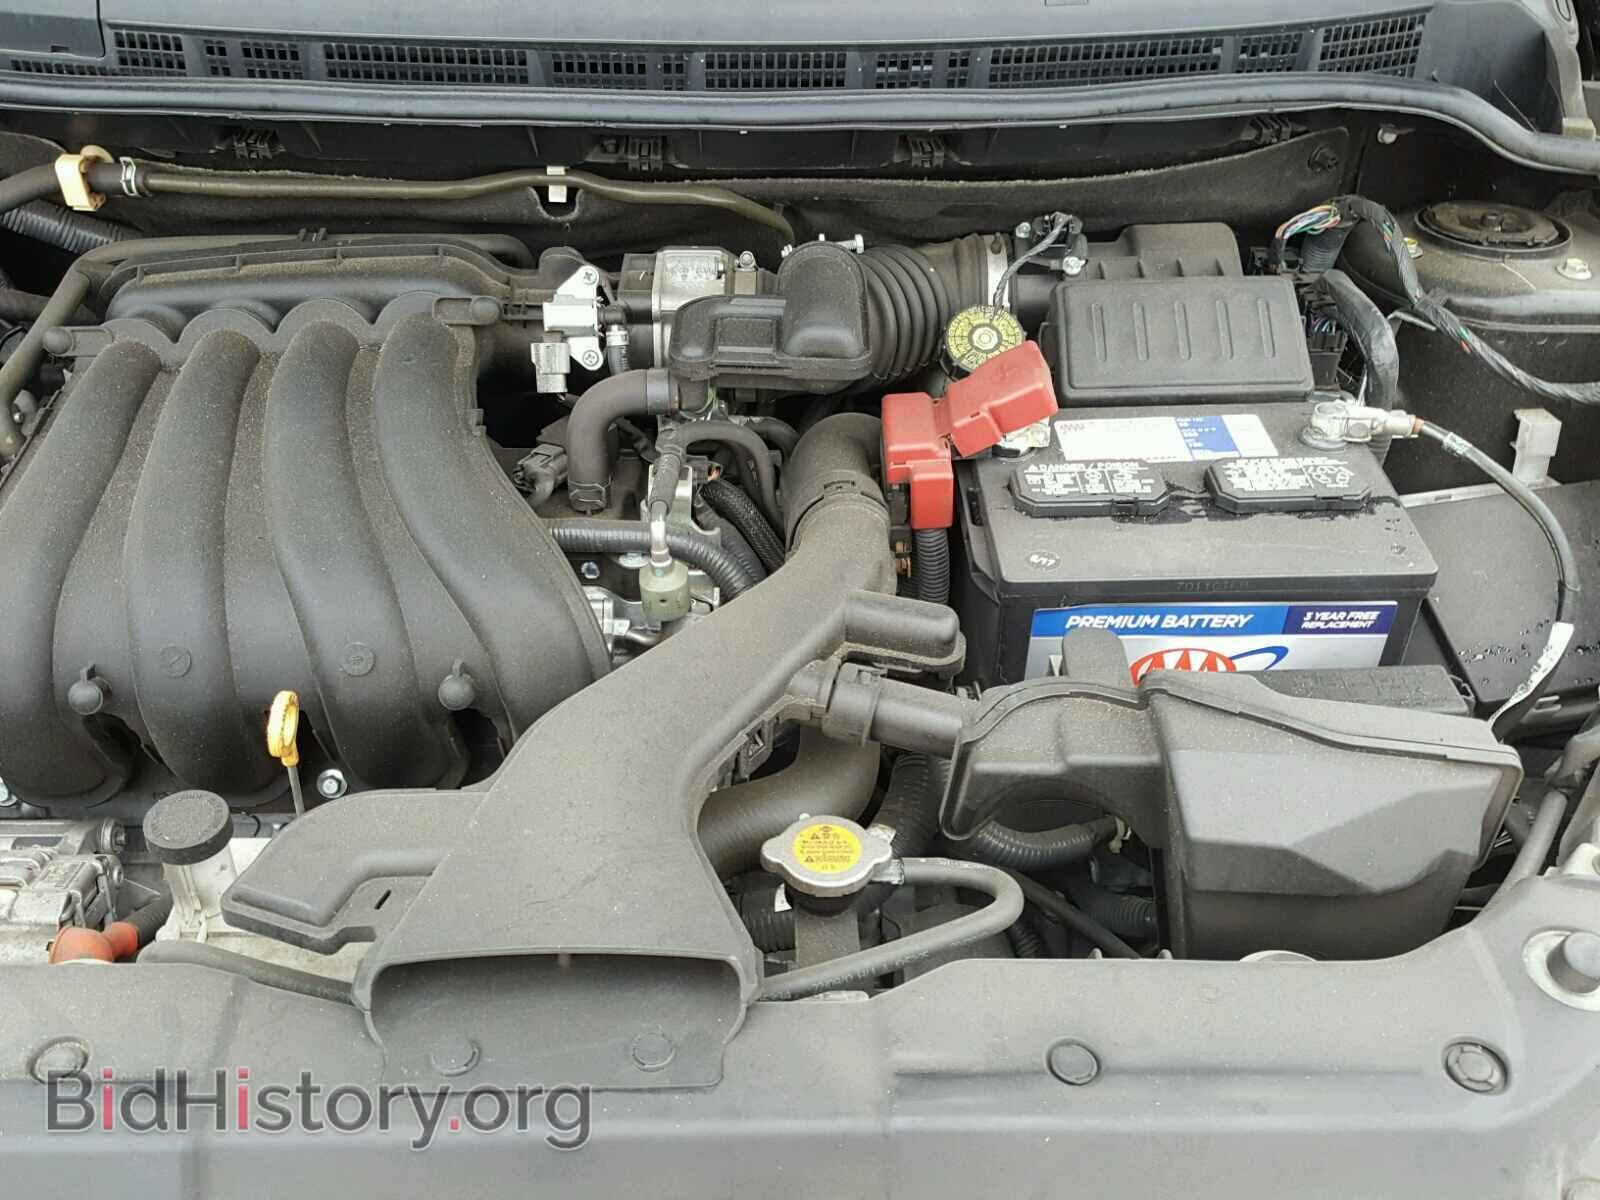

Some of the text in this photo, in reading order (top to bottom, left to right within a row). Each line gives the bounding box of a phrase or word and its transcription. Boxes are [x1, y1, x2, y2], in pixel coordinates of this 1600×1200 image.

[1314, 611, 1345, 620] YEAR
[1346, 611, 1380, 620] FREE
[1065, 613, 1254, 629] PREMIUM BATTERY
[1301, 620, 1375, 629] REPLACEMENT
